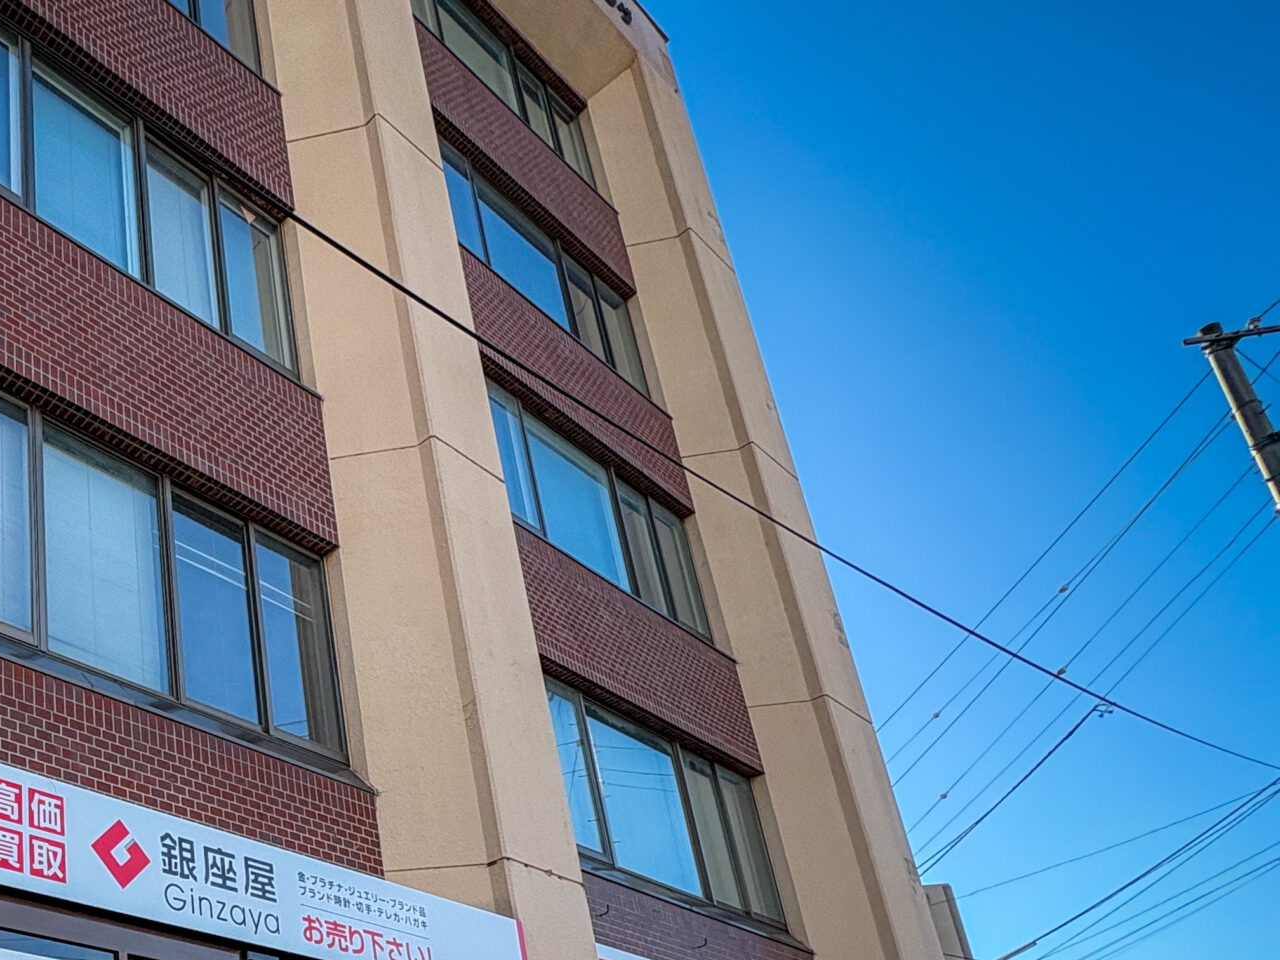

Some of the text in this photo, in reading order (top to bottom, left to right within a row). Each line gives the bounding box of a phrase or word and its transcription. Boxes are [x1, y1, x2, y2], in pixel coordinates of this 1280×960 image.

[160, 832, 278, 904] 銀座屋
[164, 883, 281, 936] Ginzaya
